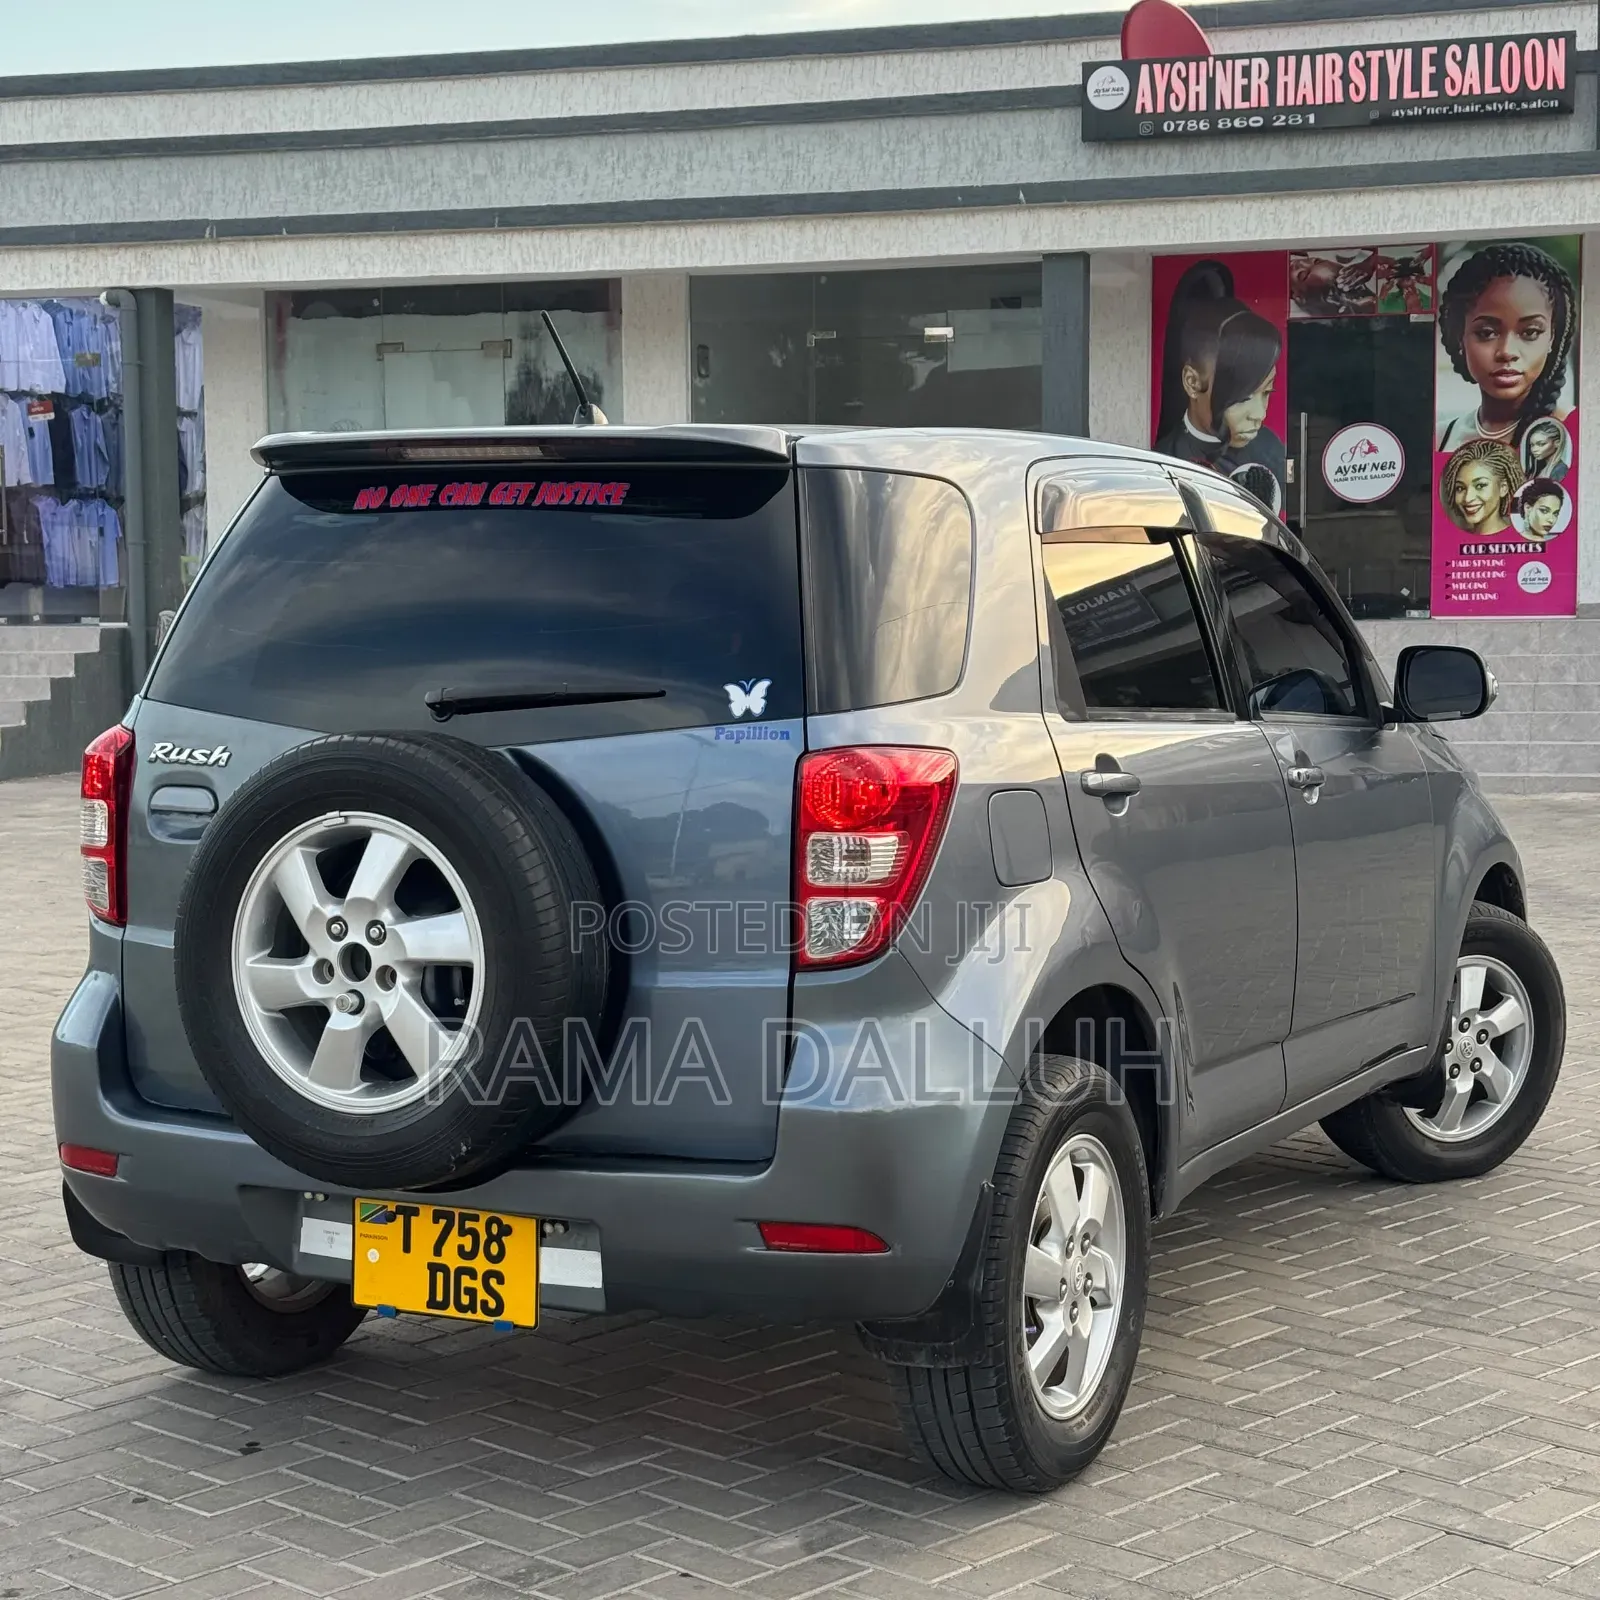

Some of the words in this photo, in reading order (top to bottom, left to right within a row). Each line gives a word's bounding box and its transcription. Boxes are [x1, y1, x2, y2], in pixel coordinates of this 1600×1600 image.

[1135, 55, 1268, 115] AYSH'NER
[1276, 51, 1345, 109] HAIR
[1348, 46, 1438, 104] STYLE
[1444, 38, 1567, 97] SALOON
[1163, 118, 1210, 133] 0786
[1217, 115, 1264, 129] 860
[1272, 112, 1316, 126] 281
[353, 486, 387, 509] NO
[390, 484, 438, 508] ONE
[489, 481, 536, 506] GET
[532, 481, 631, 507] JUSTICE
[1462, 544, 1486, 554] OUR
[1488, 542, 1543, 554] SERVICES
[1451, 560, 1472, 568] HAIR
[1473, 559, 1506, 567] STYLING
[714, 726, 790, 744] Papillion
[148, 742, 232, 767] Rush
[359, 1232, 389, 1241] PARKINSON
[396, 1204, 420, 1254] T
[432, 1208, 507, 1265] 758
[426, 1261, 506, 1318] DGS
